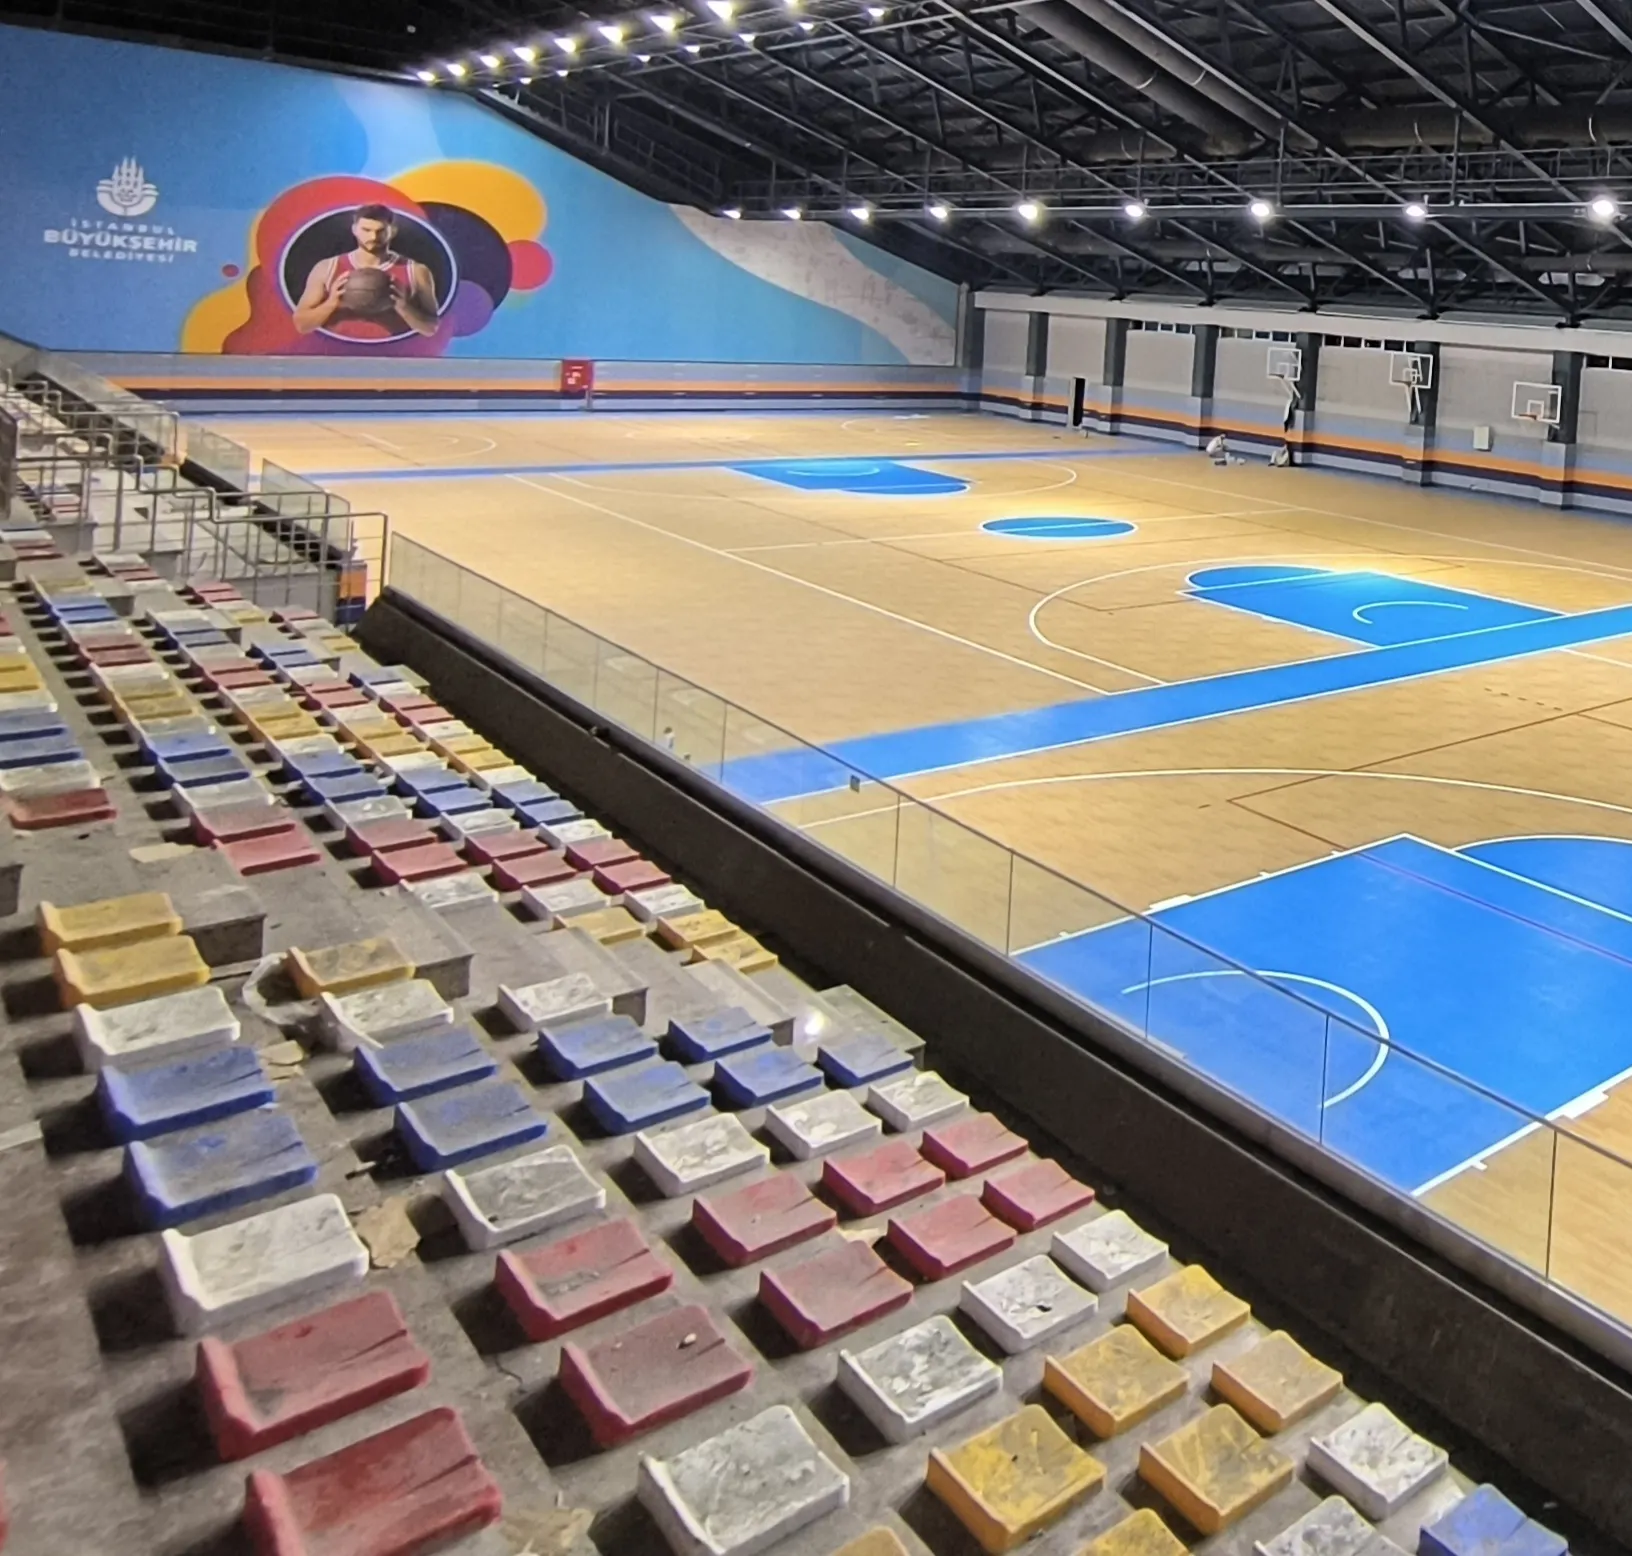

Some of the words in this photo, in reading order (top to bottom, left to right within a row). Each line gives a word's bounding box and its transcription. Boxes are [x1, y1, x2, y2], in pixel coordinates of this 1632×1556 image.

[70, 217, 176, 236] İSTANBUL
[43, 228, 198, 253] BÜYÜKŞEHİR
[68, 248, 174, 263] BELEDİYESİ
